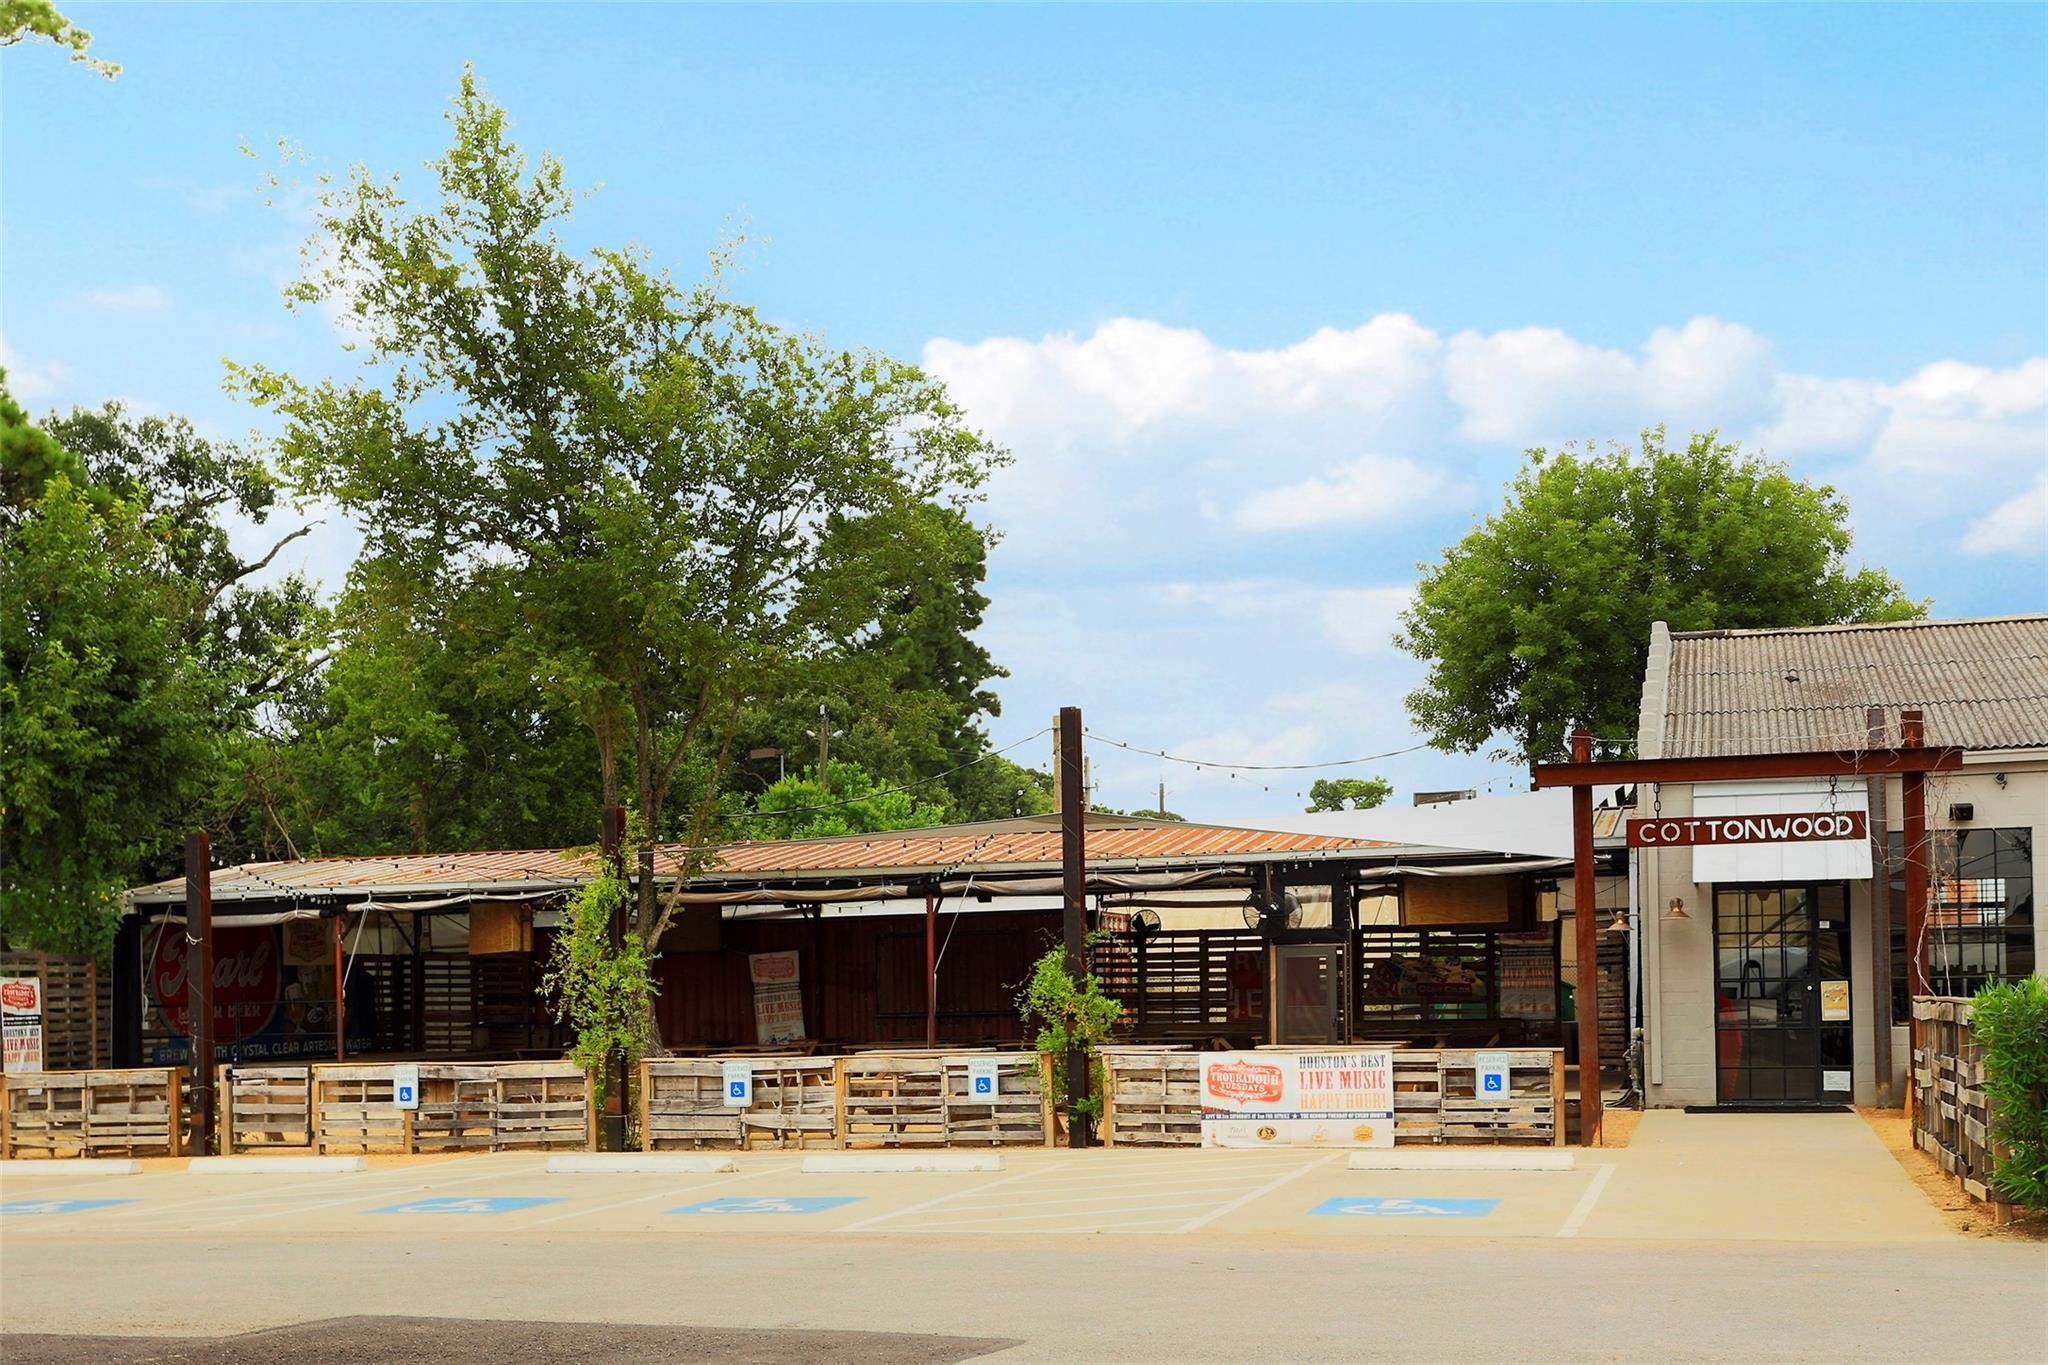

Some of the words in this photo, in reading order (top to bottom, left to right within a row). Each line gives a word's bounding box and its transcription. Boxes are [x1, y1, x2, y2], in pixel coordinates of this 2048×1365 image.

[1639, 815, 1853, 843] COTTONWOOD
[159, 929, 273, 998] Parl
[230, 1043, 270, 1058] CYSTAL
[271, 1041, 300, 1055] CLEAR
[302, 1037, 337, 1053] ARTESIA
[1299, 1055, 1357, 1069] HOUSTON'S
[1361, 1054, 1386, 1068] BEST
[1221, 1082, 1265, 1092] TUESDAYS
[1299, 1071, 1334, 1089] LIVE
[1338, 1070, 1386, 1089] MUSIC
[1300, 1093, 1342, 1109] HAPPY
